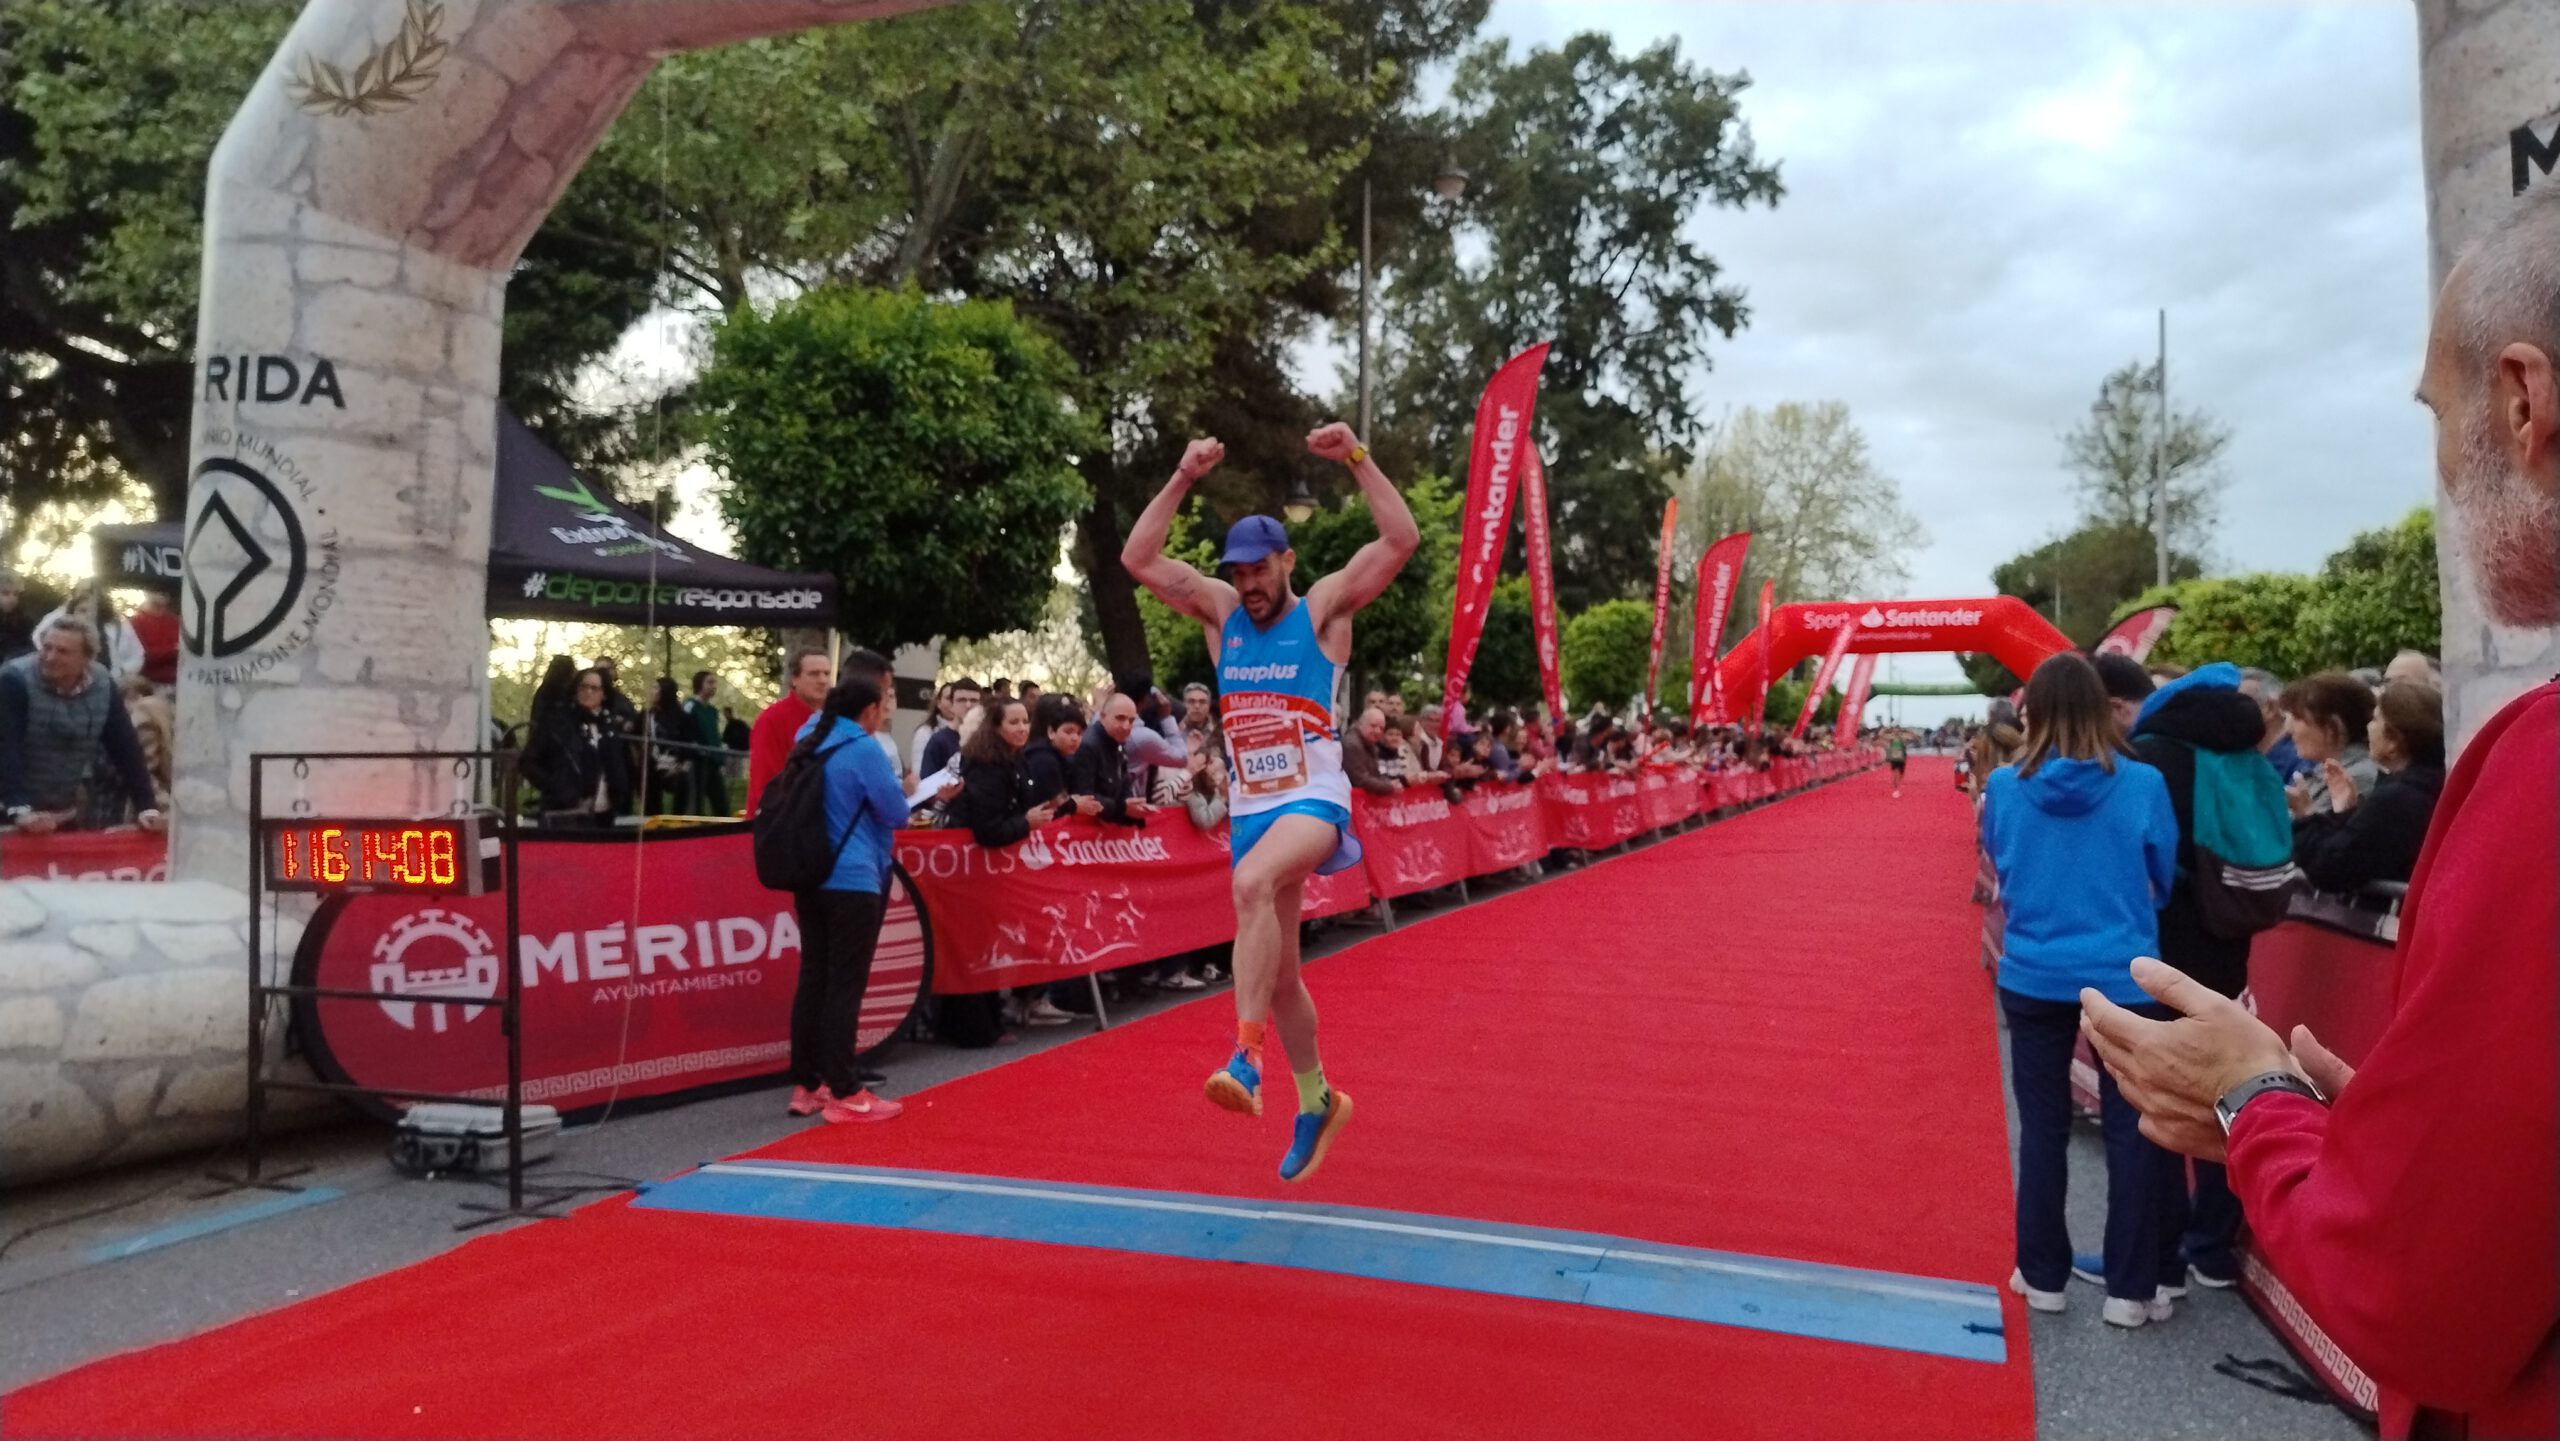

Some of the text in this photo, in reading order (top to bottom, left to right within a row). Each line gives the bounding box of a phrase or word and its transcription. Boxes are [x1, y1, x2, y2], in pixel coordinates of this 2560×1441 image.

[236, 433, 318, 502] MUNDIAL
[197, 528, 341, 686] PATRIMOINE MONDIAL
[1885, 608, 1984, 627] Santander
[1246, 753, 1288, 775] 2498
[1054, 831, 1170, 866] Santander
[519, 911, 802, 988] MÉRIDA
[592, 969, 763, 1005] AYUNTAMIENTO
